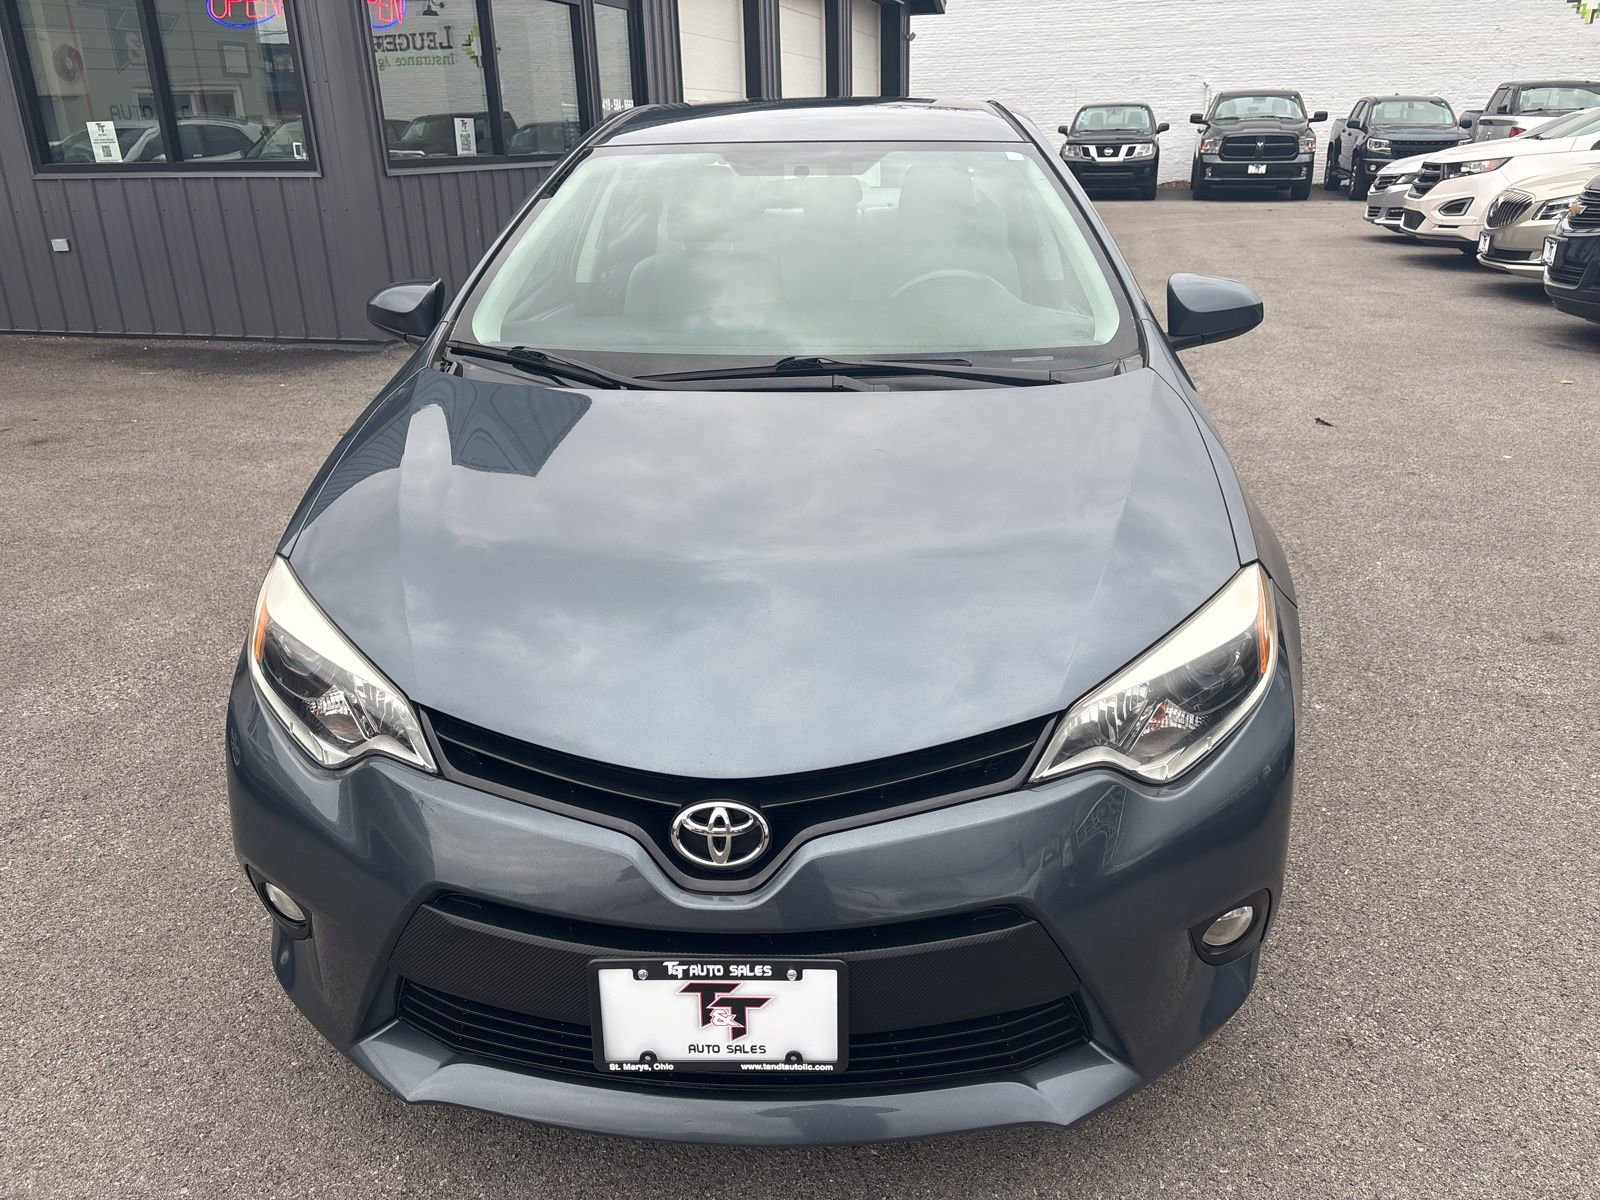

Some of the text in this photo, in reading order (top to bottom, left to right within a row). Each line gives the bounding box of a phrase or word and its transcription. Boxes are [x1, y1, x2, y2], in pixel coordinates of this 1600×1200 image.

[689, 963, 724, 978] AUTO
[729, 964, 773, 977] SALES
[688, 1044, 767, 1055] AUTO SALES
[609, 1063, 675, 1072] St. Marys, Ohio
